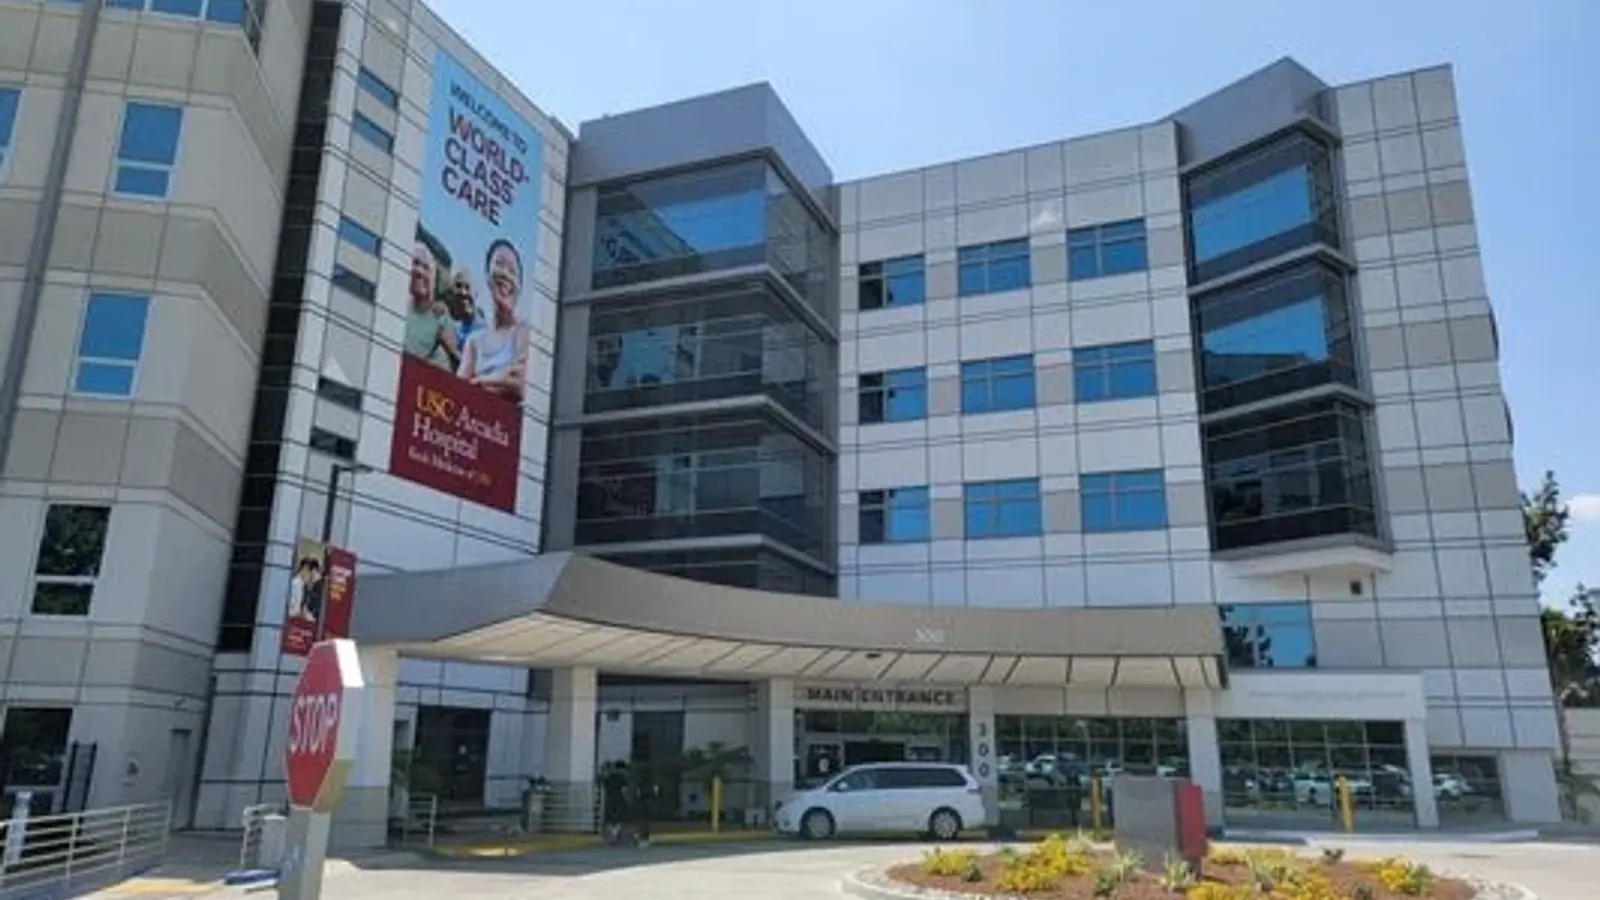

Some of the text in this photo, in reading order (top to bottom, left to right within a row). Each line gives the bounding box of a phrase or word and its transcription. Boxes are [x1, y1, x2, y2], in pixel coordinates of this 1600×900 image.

[441, 166, 501, 228] CARE
[444, 136, 515, 206] CLASS
[416, 384, 453, 425] USC
[411, 411, 479, 460] Hospital
[807, 688, 955, 705] MAIN ENTRANCE
[290, 693, 338, 757] STOP
